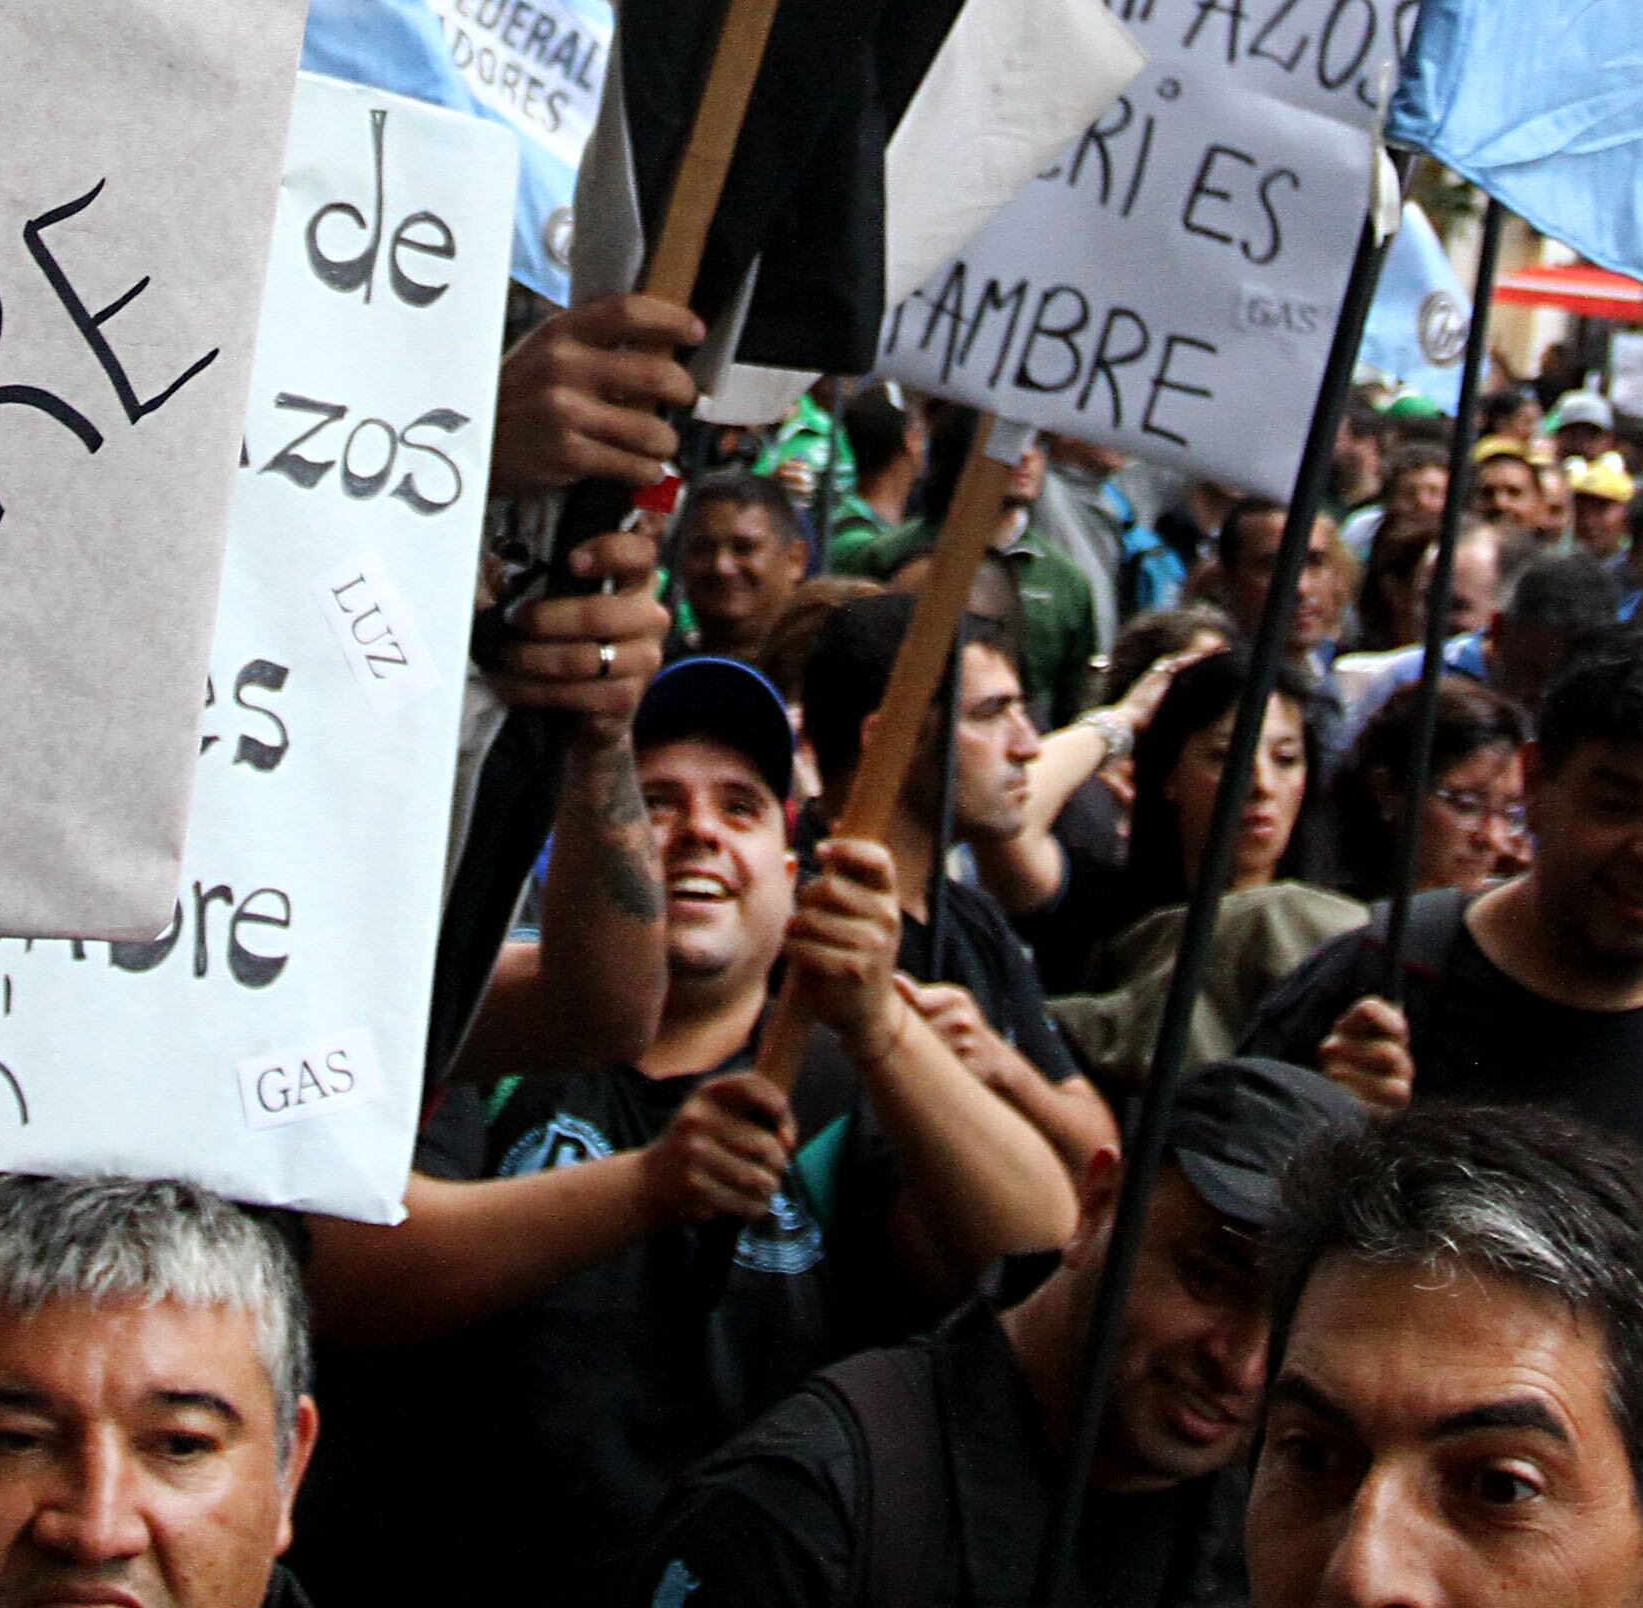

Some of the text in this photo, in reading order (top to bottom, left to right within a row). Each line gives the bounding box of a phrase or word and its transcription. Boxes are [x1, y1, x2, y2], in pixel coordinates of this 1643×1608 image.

[304, 109, 456, 309] de
[1182, 144, 1300, 265] ES
[331, 572, 410, 680] LUZ
[254, 1049, 357, 1115] GAS
